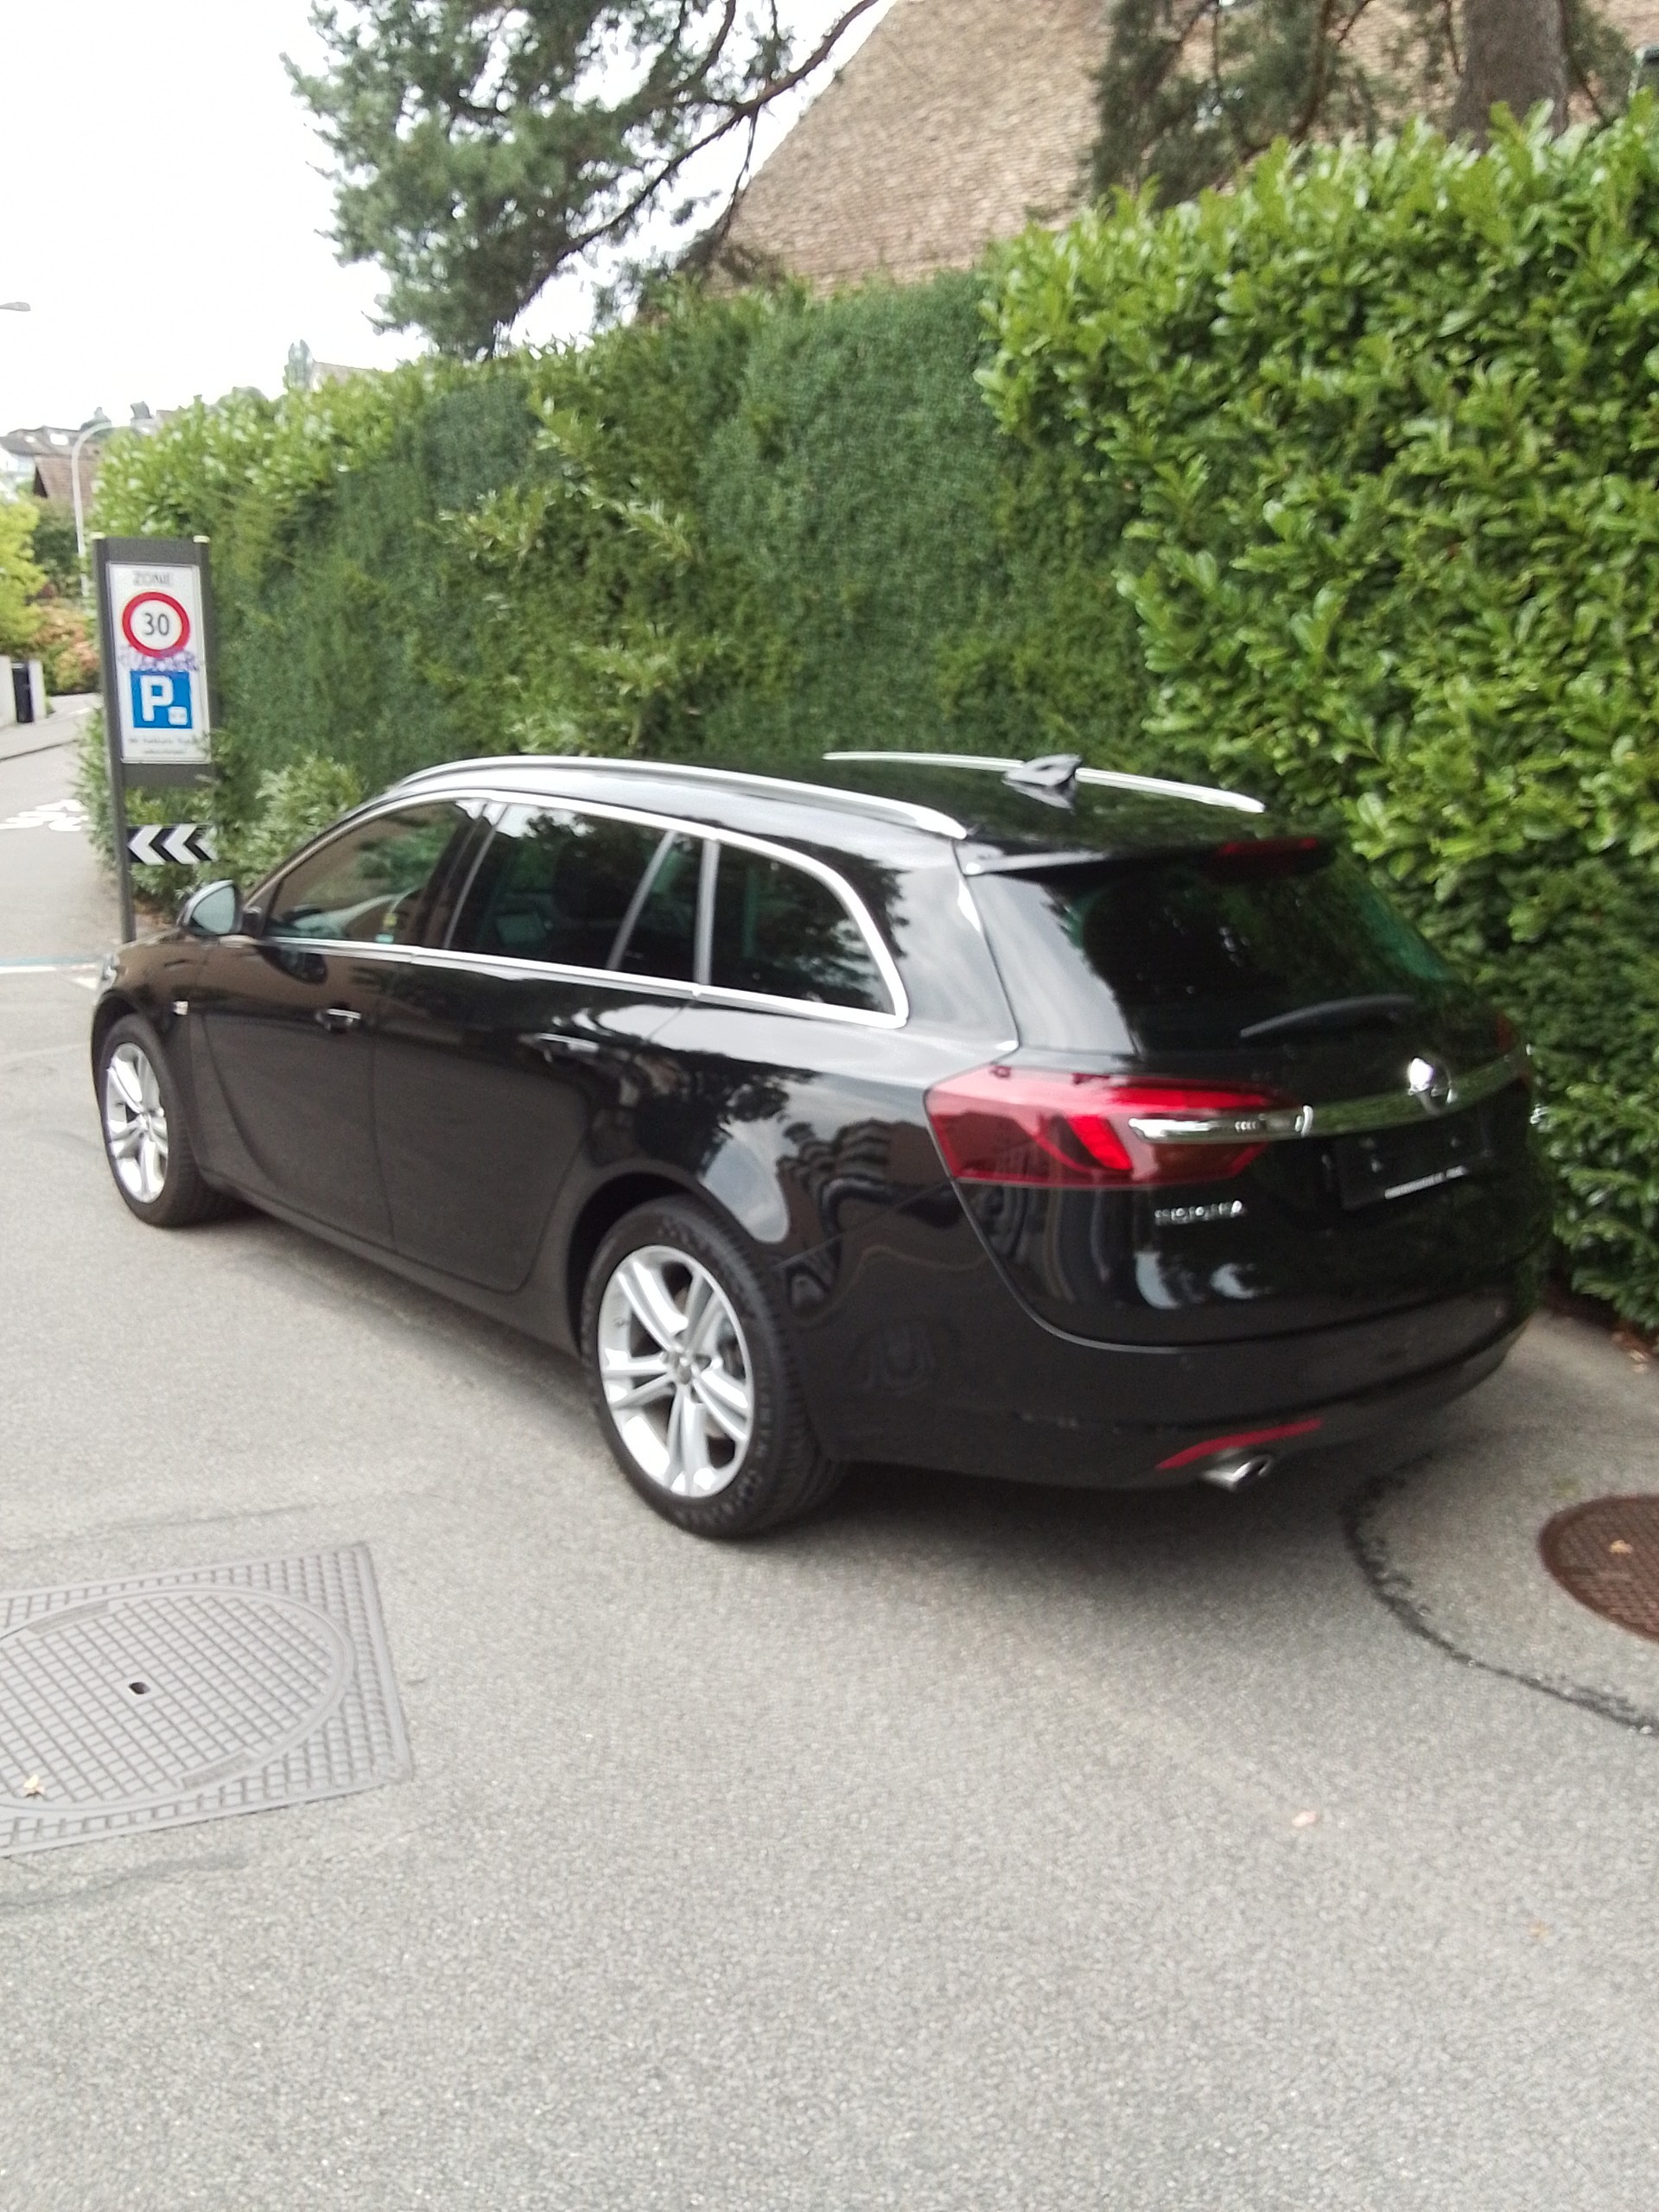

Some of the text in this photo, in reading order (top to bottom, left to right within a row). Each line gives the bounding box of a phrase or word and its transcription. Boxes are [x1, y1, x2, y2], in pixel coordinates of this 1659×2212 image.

[132, 570, 173, 587] ZONE
[143, 612, 170, 636] 30
[140, 675, 173, 721] P
